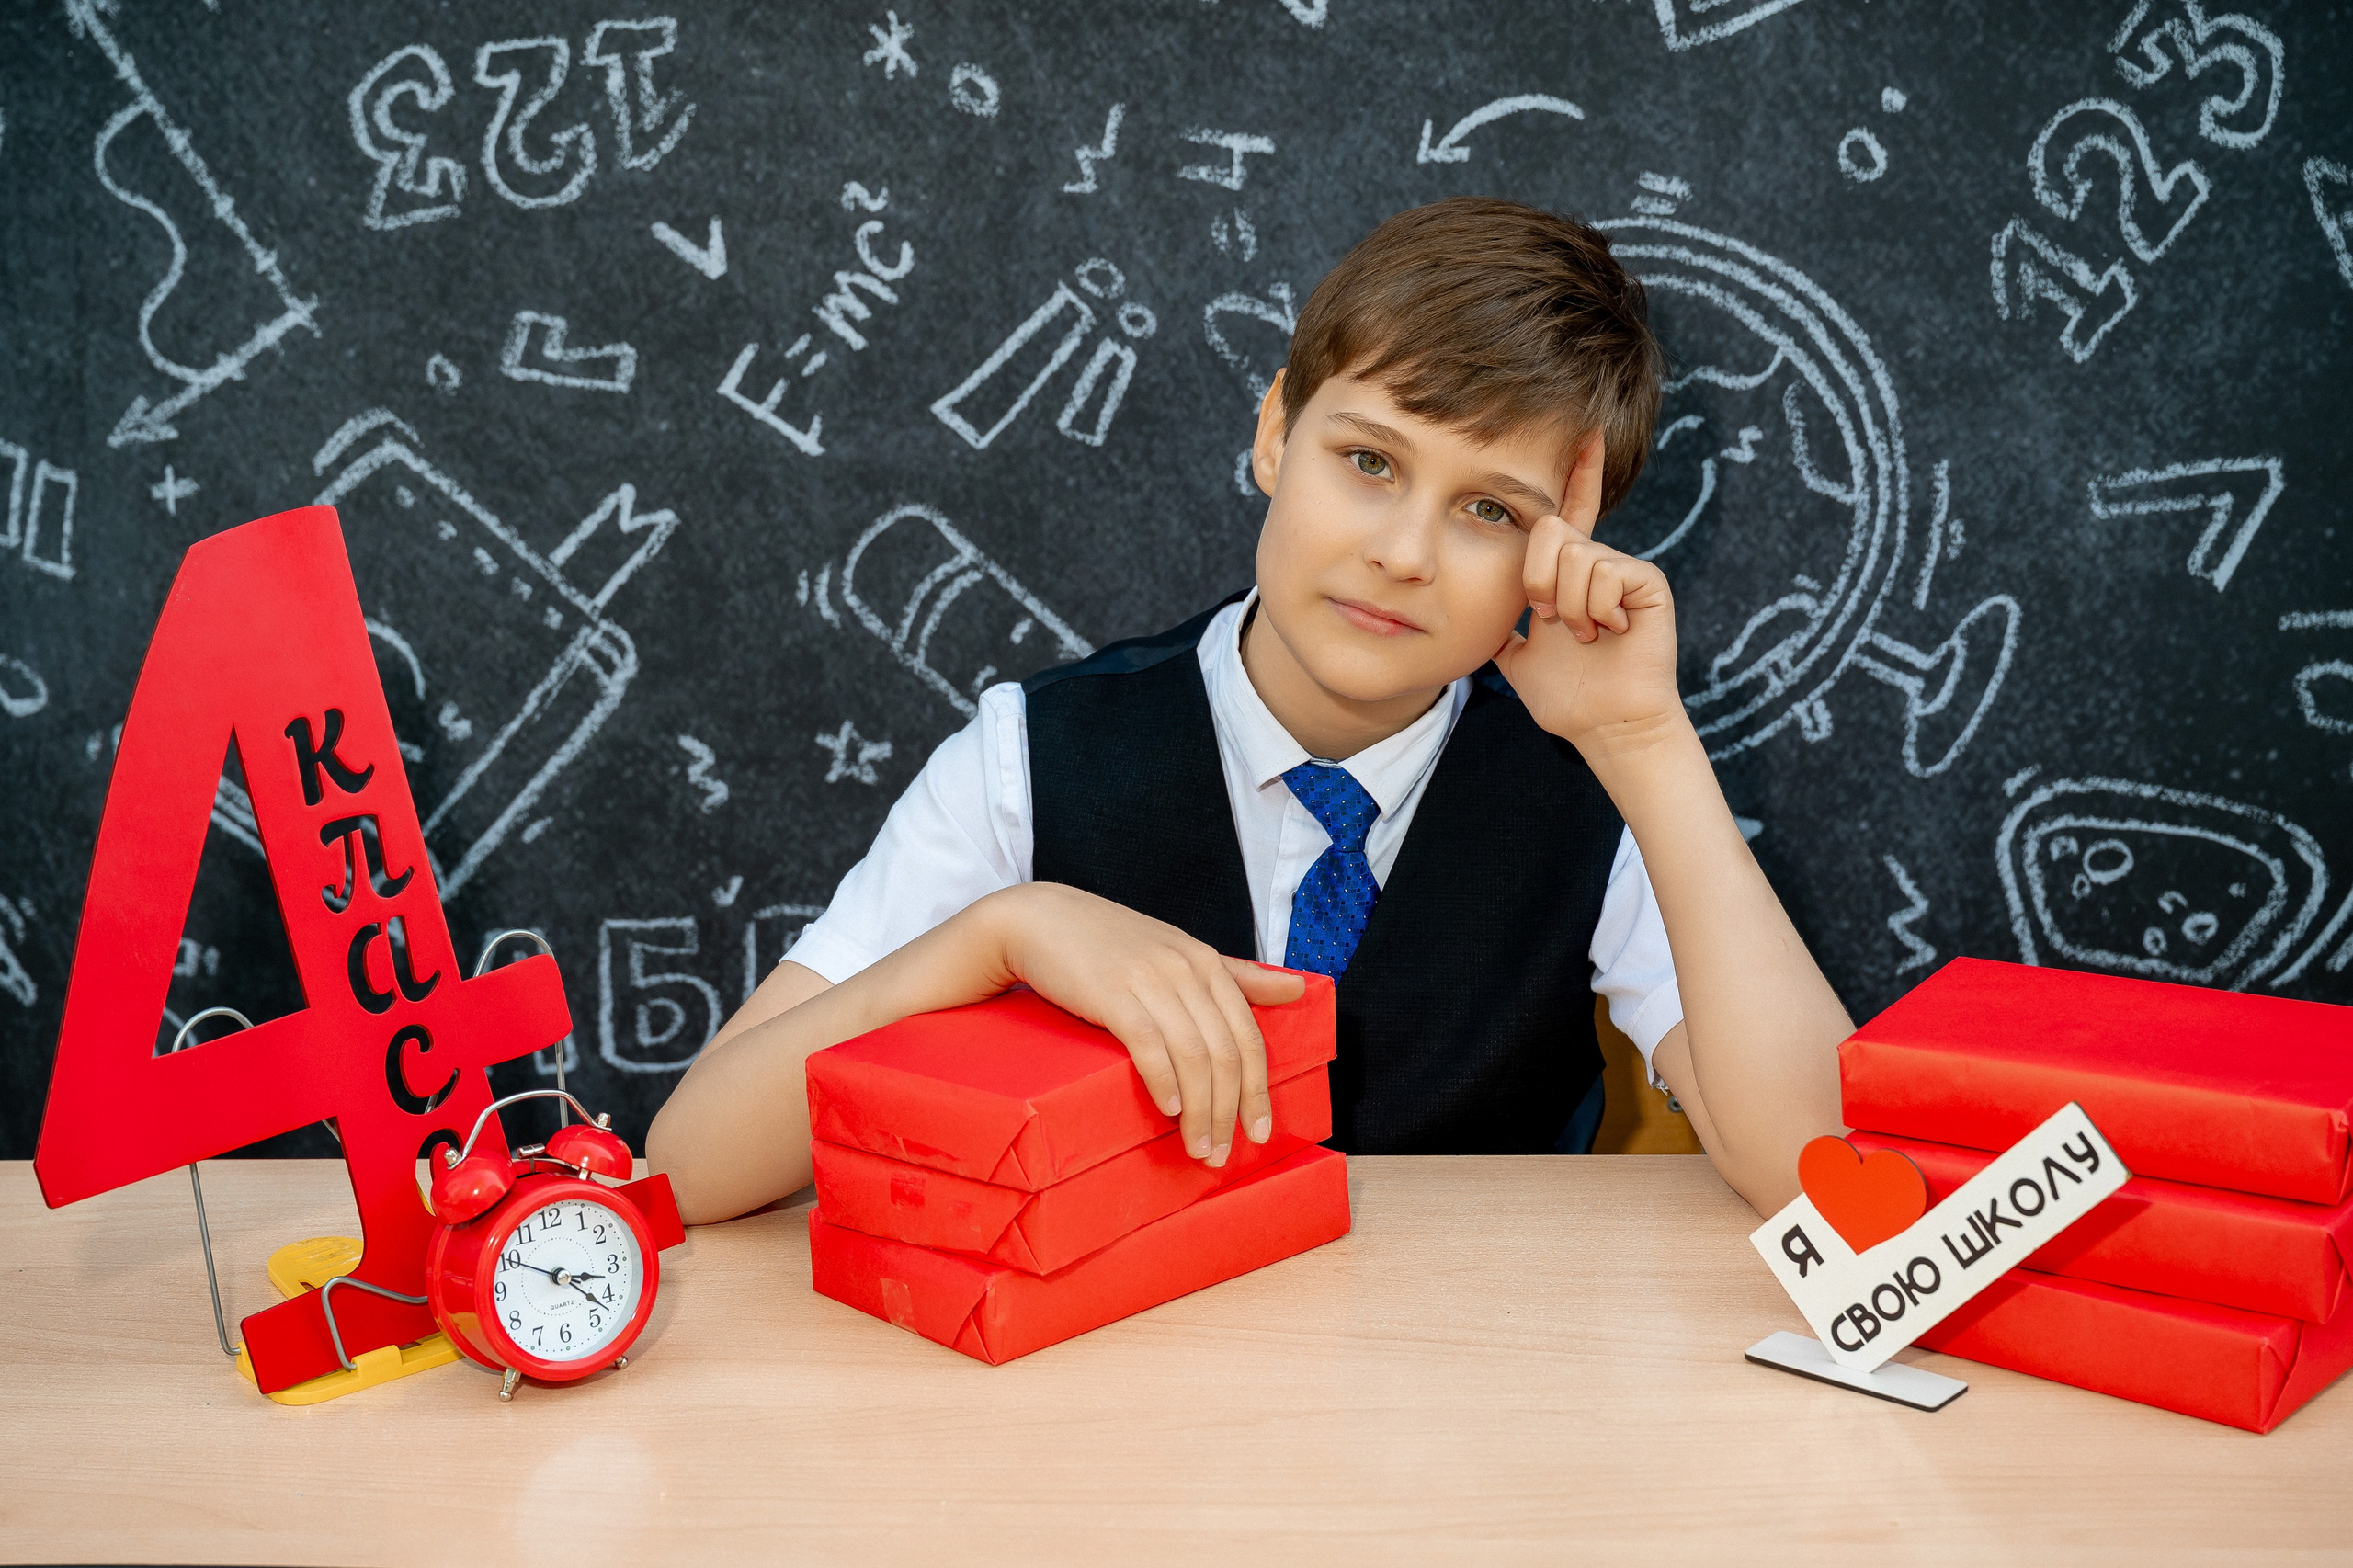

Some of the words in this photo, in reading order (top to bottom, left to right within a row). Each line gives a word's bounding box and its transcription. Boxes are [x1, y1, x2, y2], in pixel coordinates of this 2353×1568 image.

[538, 1207, 562, 1231] 12
[575, 1210, 588, 1231] 1
[516, 1222, 536, 1245] 11
[593, 1225, 607, 1245] 2
[1831, 1256, 1941, 1352] СВОЮ
[1940, 1131, 2100, 1269] ШКОЛУ
[498, 1249, 521, 1273] 10
[1781, 1224, 1824, 1278] Я
[607, 1254, 620, 1274] 3
[494, 1281, 506, 1301] 9
[601, 1283, 615, 1303] 4
[550, 1300, 574, 1311] QUARTZ
[509, 1310, 522, 1331] 8
[588, 1308, 601, 1328] 5
[532, 1325, 544, 1346] 7
[559, 1323, 572, 1343] 6
